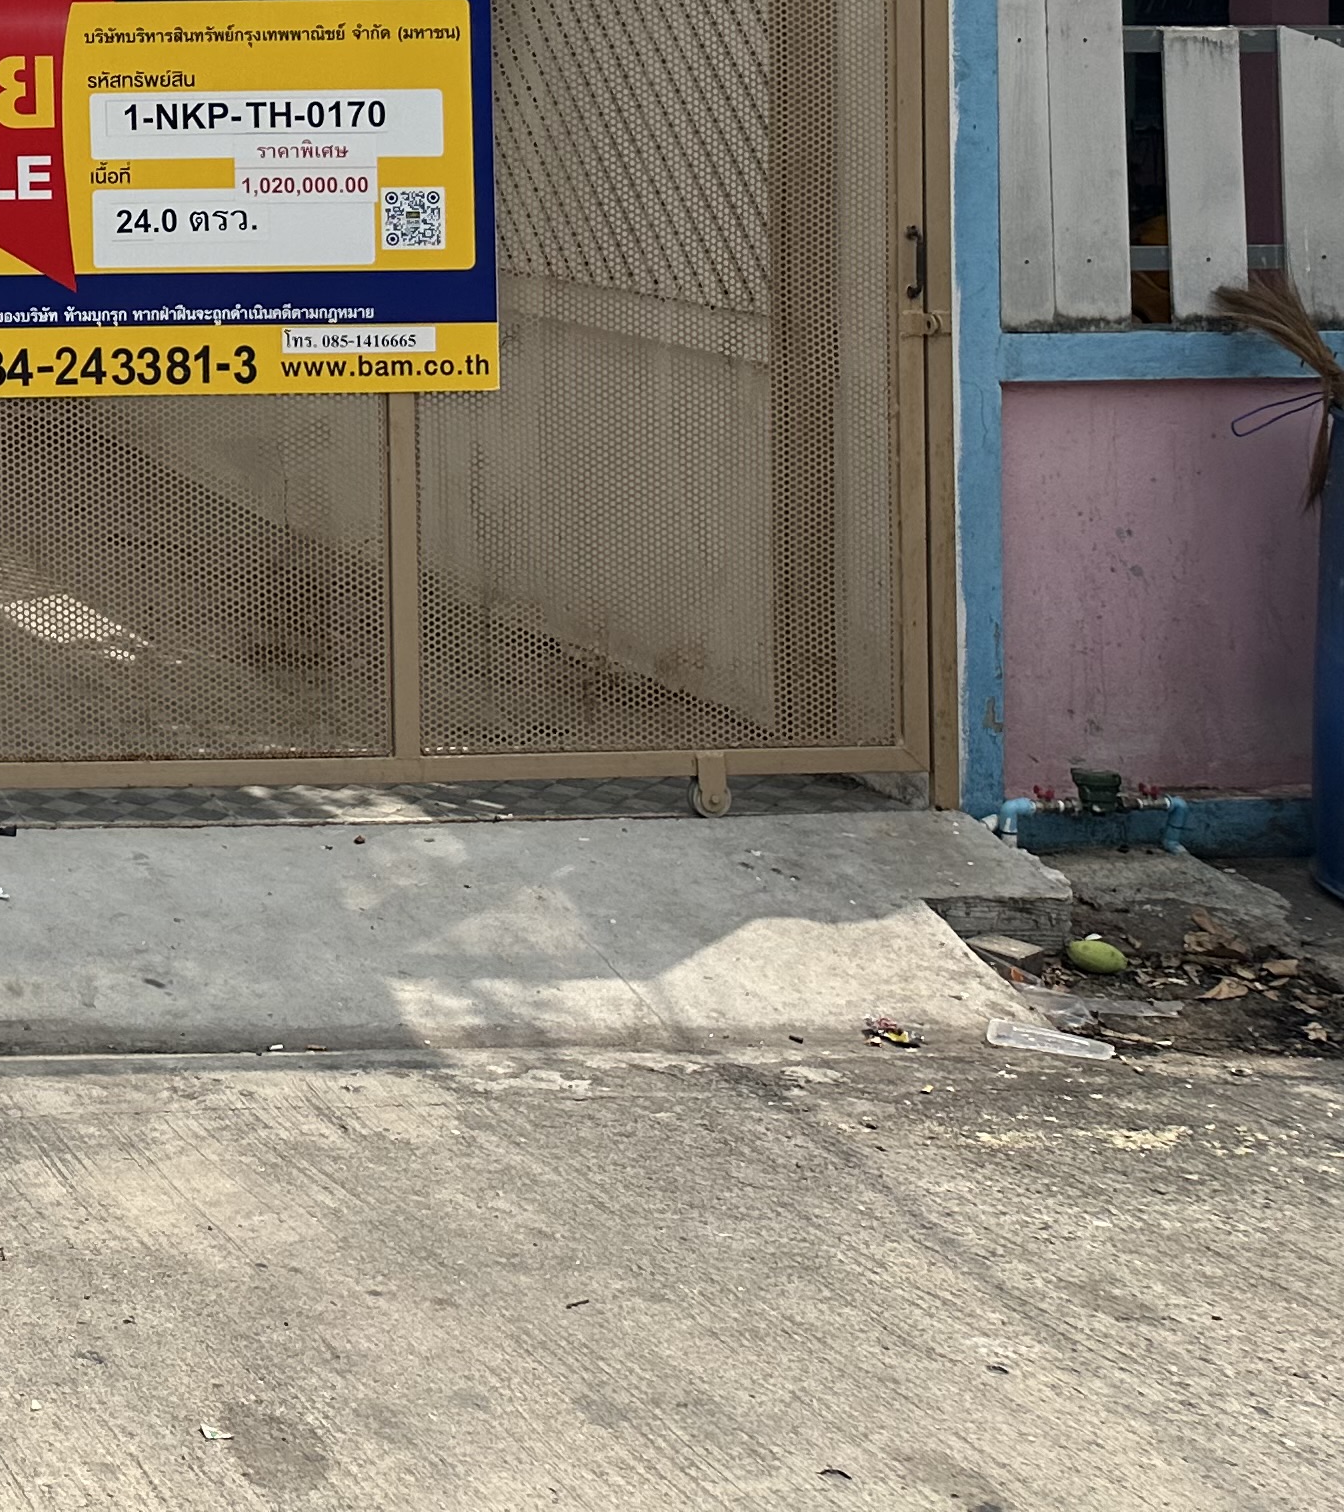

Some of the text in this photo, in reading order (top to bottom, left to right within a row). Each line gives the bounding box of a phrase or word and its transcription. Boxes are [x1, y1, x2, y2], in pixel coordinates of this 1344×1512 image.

[84, 23, 461, 48] บริษัทบริหารสินทรัพย์กรุงเทพพาณิชย์ จำกัด (มหาชน)
[87, 70, 195, 89] รหัสทรัพย์สิน
[123, 100, 386, 130] 1-NKP-TH-0170
[257, 139, 349, 159] ราคาพิเศษ
[90, 161, 131, 185] เนื้อที่
[241, 176, 369, 197] 1,020,000.00
[116, 209, 258, 234] 24.0 ตรว.
[64, 306, 127, 327] ห้ามบุกรุก
[132, 303, 375, 325] หากฝ่าฝืนจะถูกดำเนินคดีตามกฎหมาย
[283, 329, 417, 348] โทร. 085-1416665
[281, 354, 489, 377] www.bam.co.th
